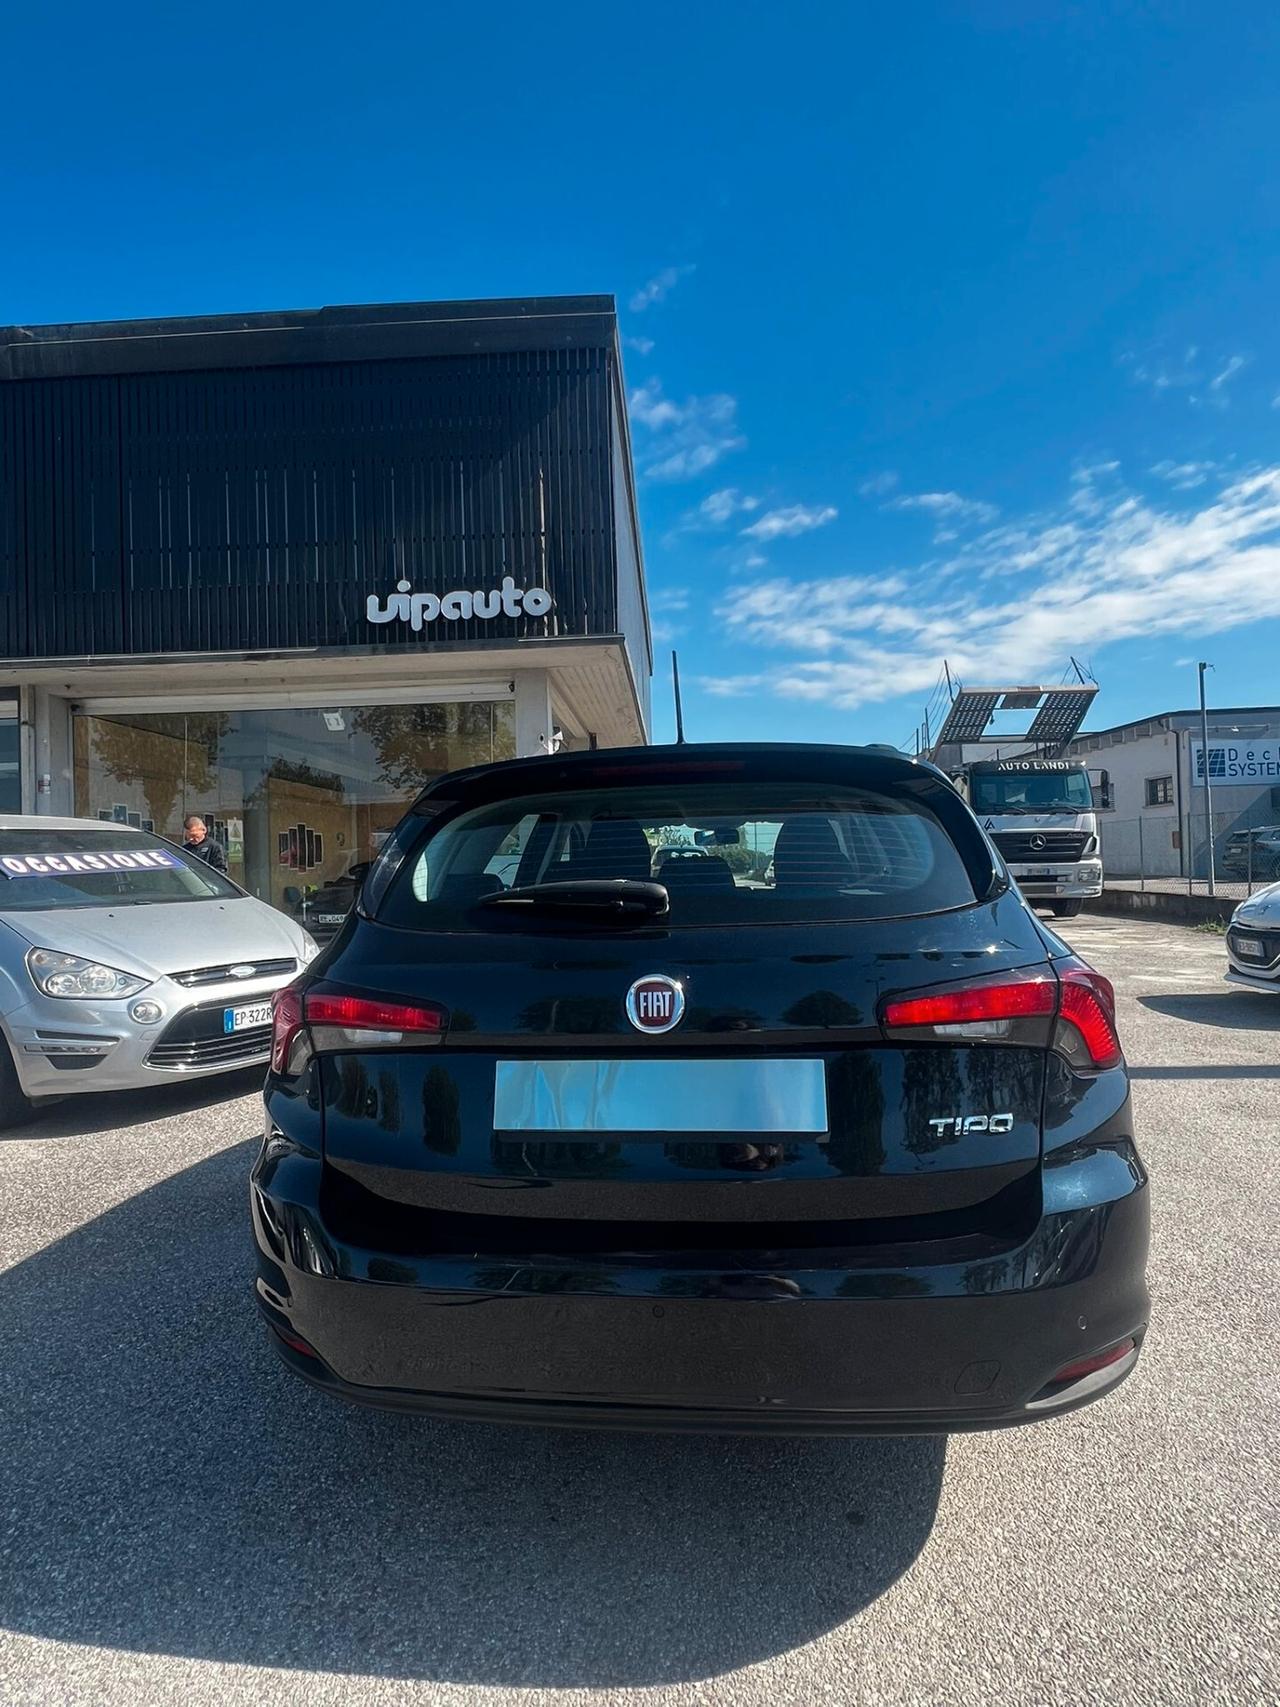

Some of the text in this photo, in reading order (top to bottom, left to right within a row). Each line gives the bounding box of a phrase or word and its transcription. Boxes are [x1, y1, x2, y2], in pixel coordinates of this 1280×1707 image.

[366, 576, 553, 632] vipauto
[998, 761, 1070, 771] AUTO LANDI
[1, 851, 174, 874] OCCASIONE
[639, 991, 672, 1018] FIAT
[928, 1112, 1014, 1137] TIPO
